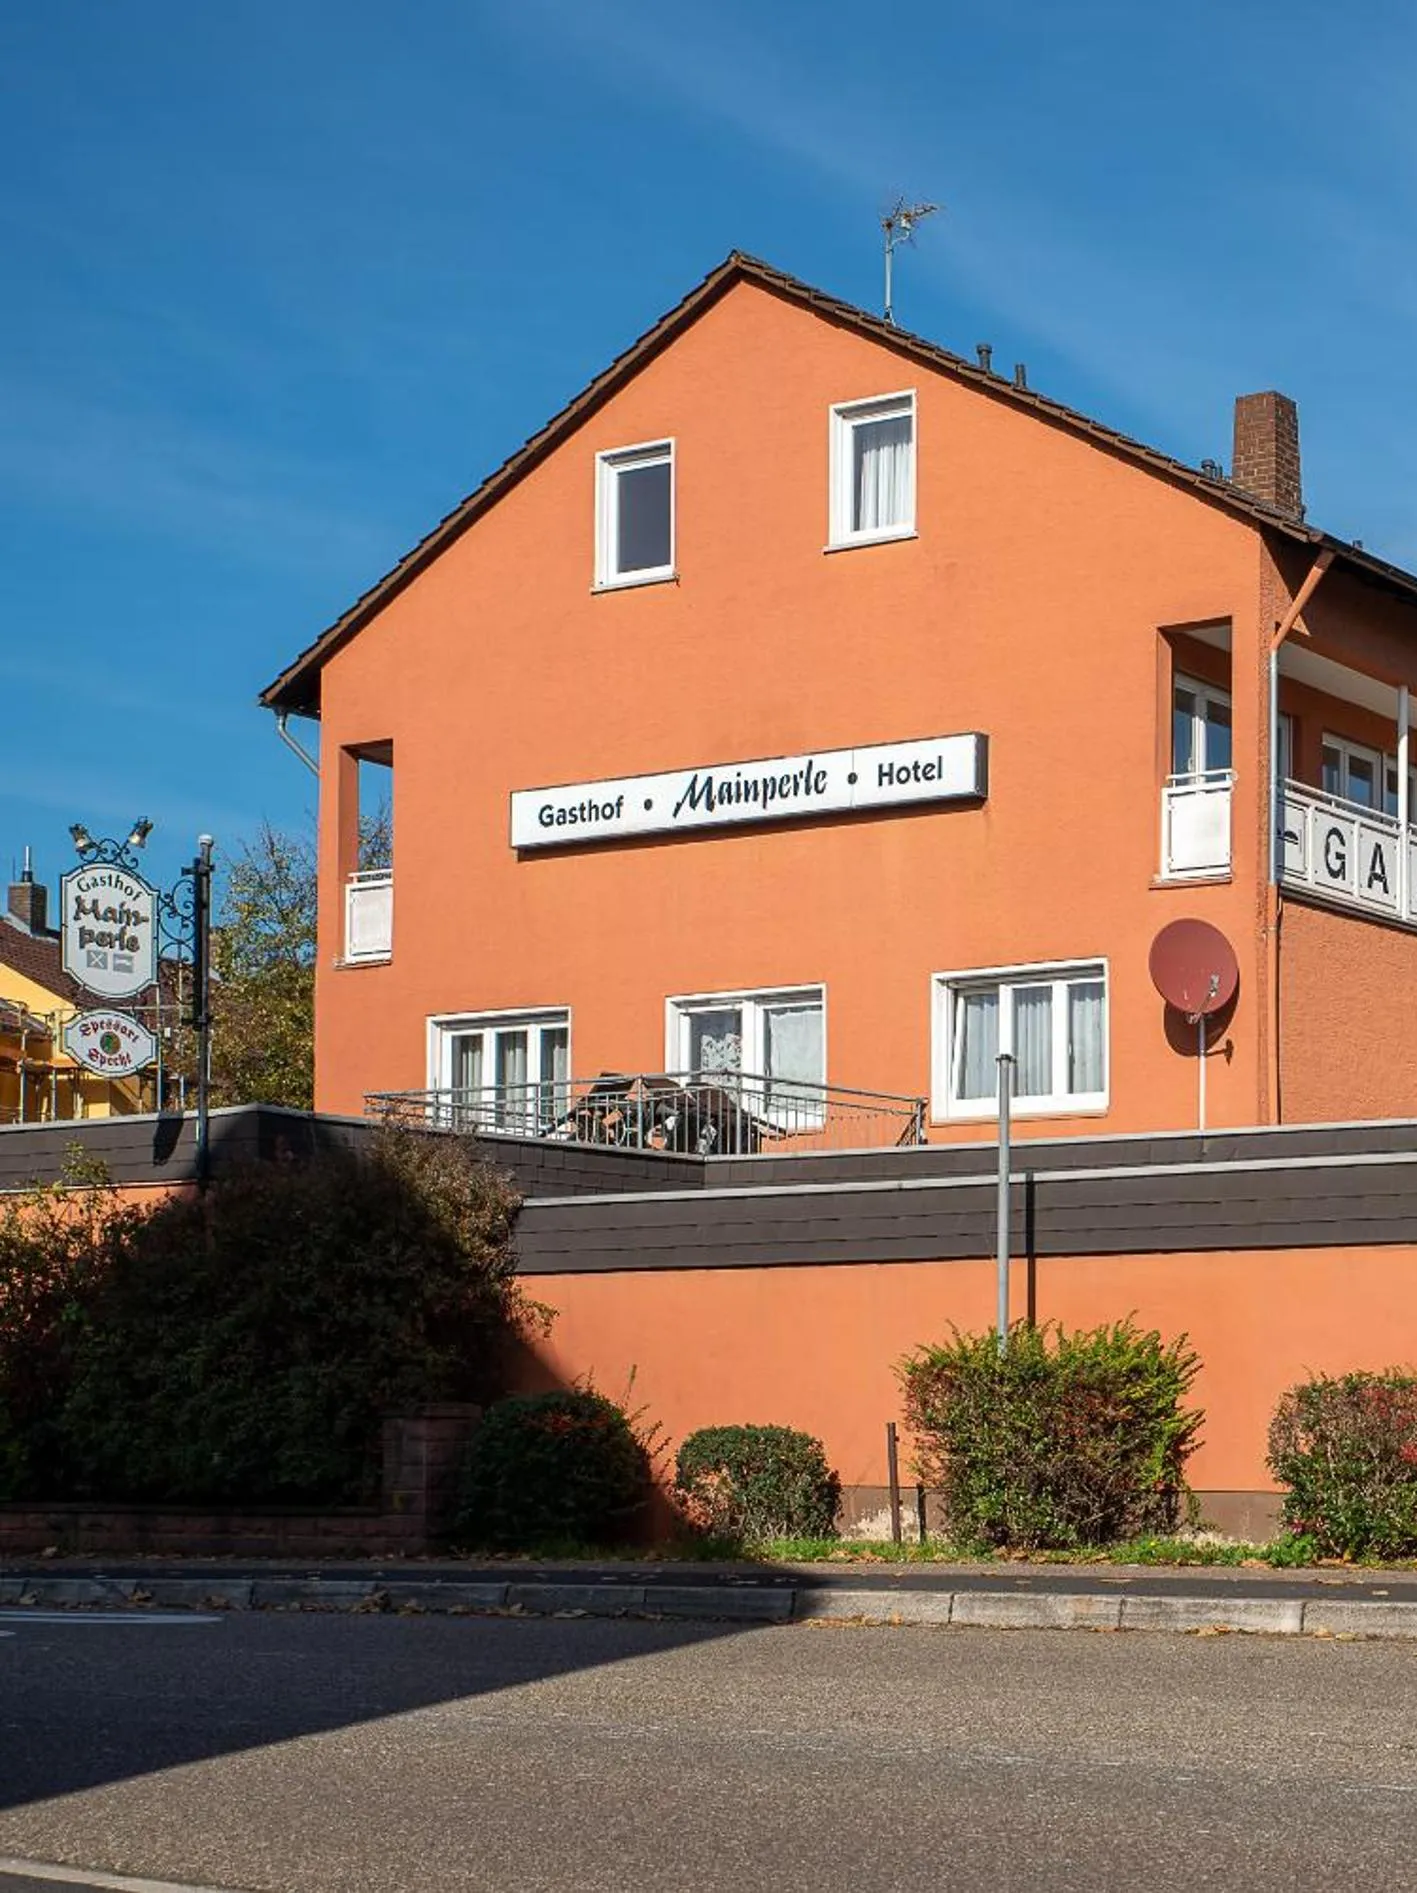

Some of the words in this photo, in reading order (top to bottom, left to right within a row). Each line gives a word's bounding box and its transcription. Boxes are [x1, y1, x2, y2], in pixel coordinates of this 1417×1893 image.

[538, 795, 624, 827] Gasthof
[672, 759, 828, 818] Mainperle
[877, 756, 943, 787] Hotel
[76, 873, 143, 901] Gasthof
[88, 1048, 131, 1067] Specht
